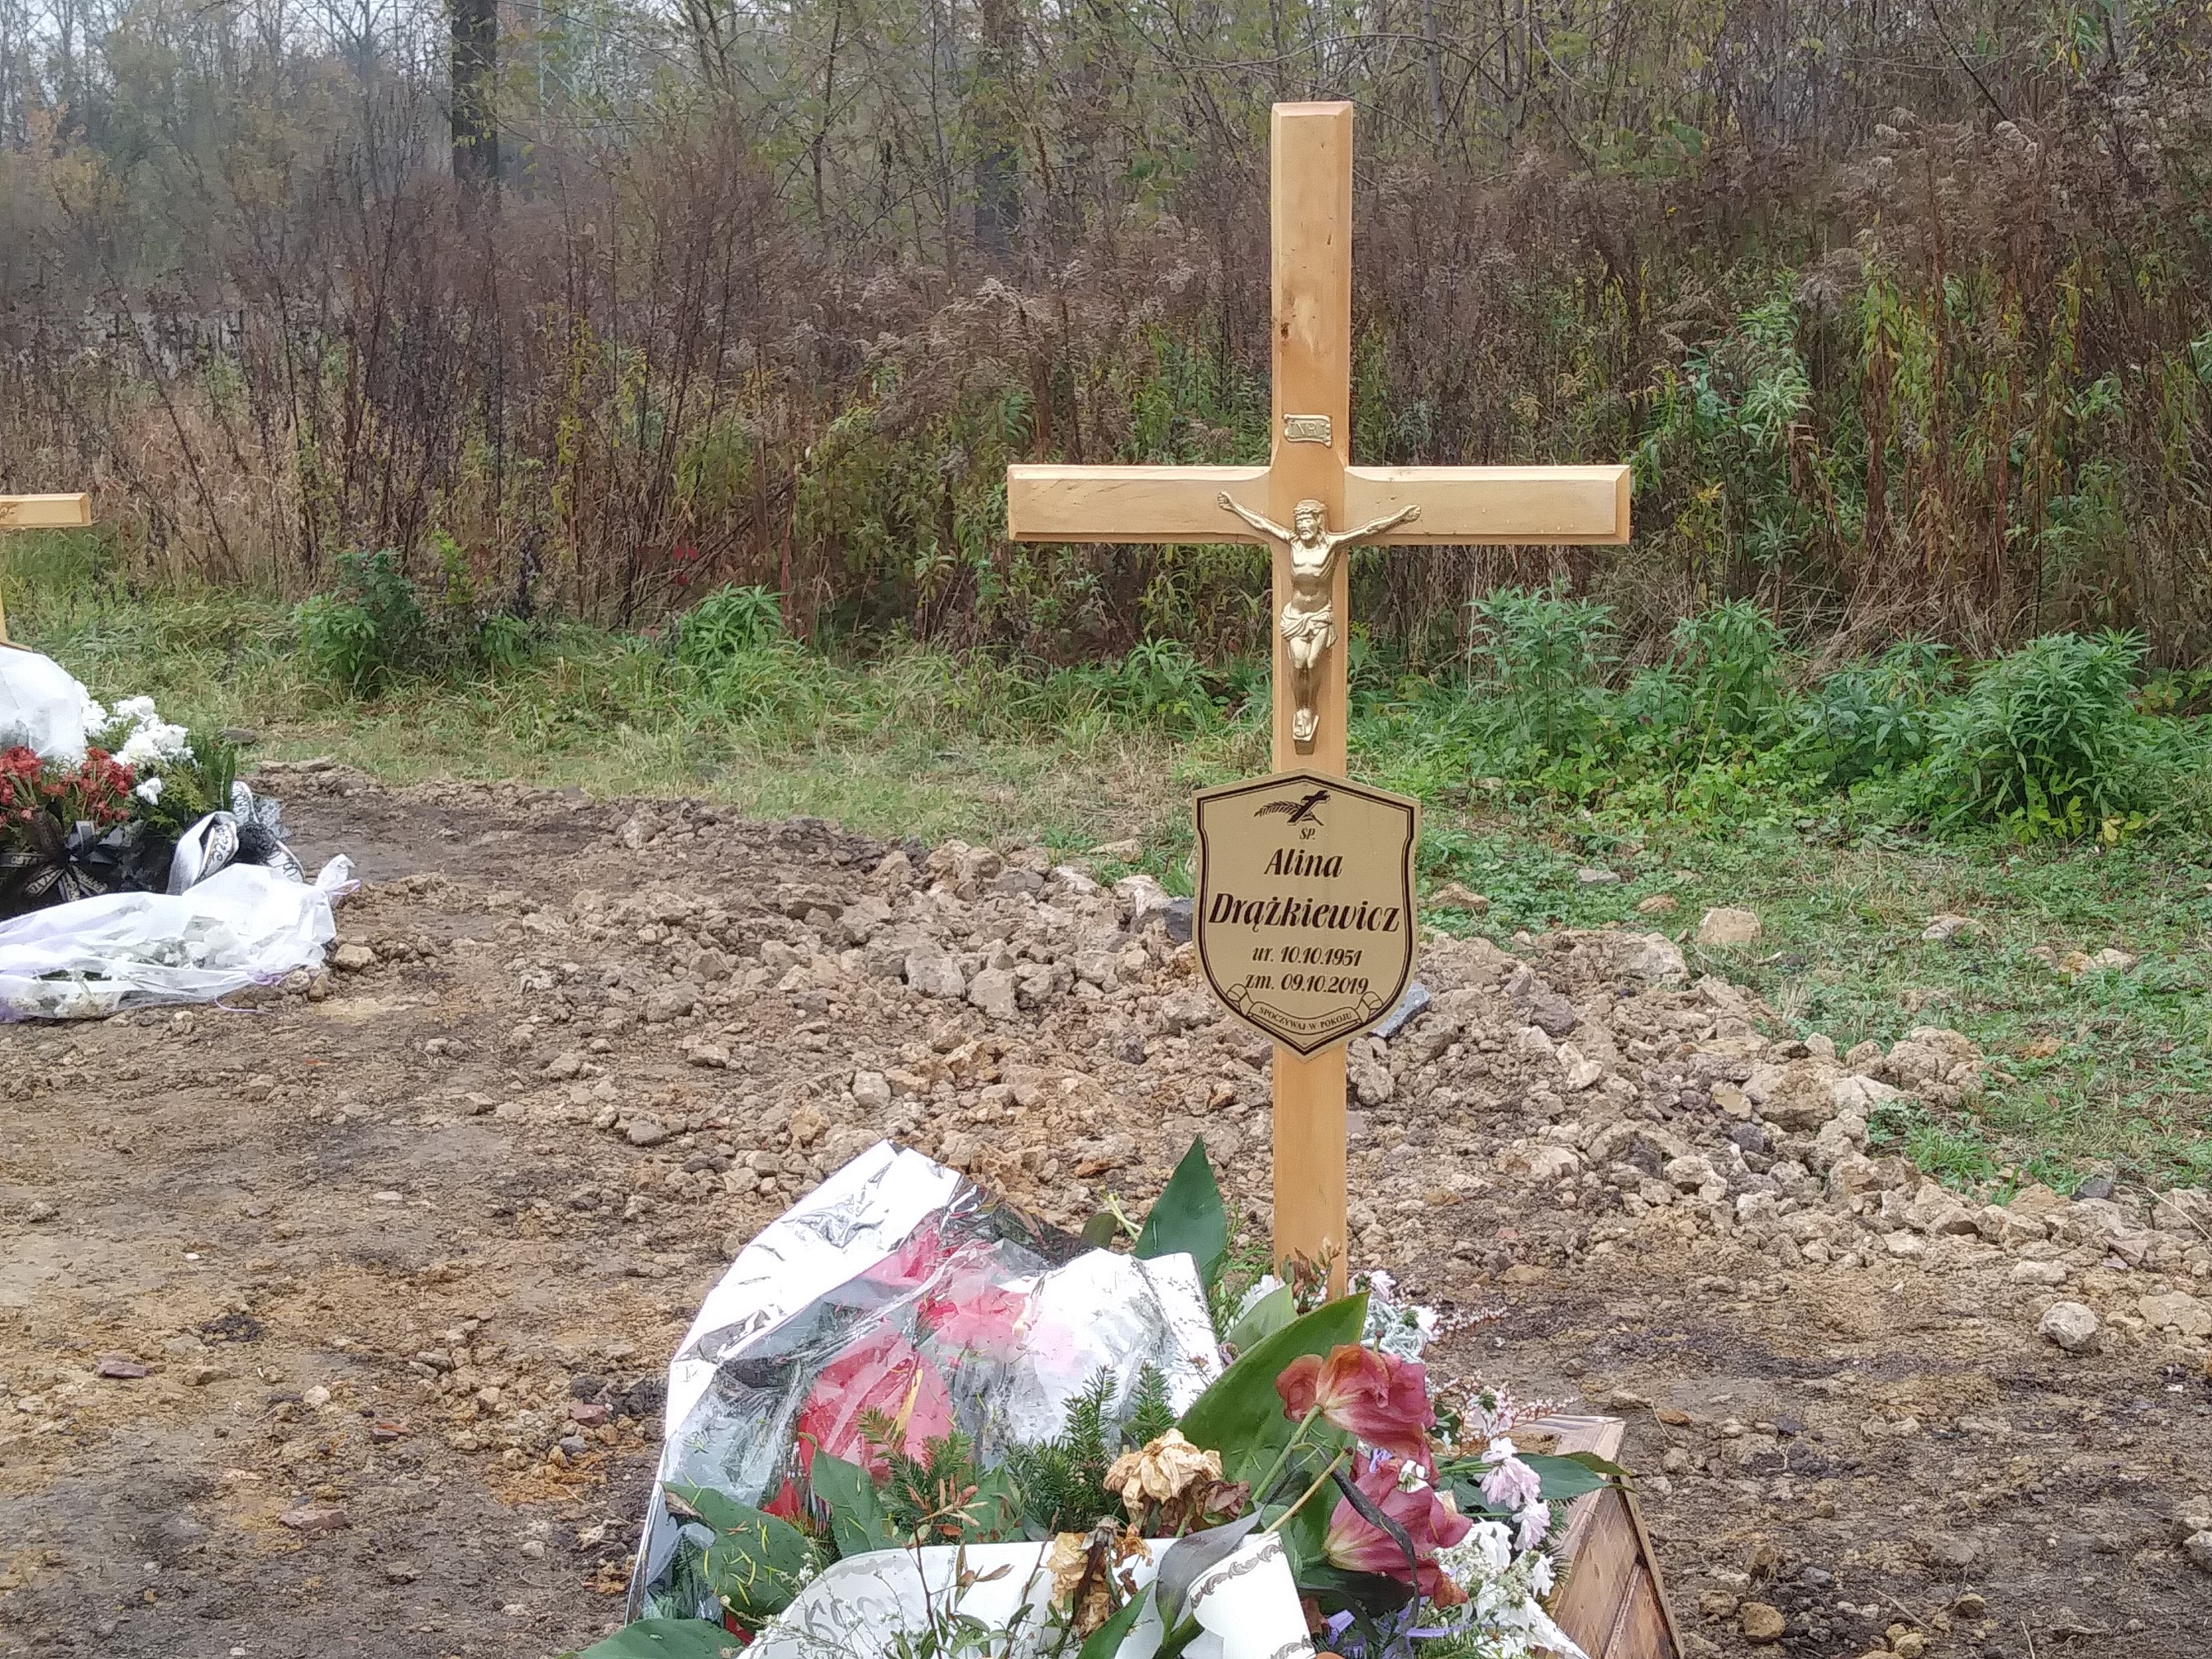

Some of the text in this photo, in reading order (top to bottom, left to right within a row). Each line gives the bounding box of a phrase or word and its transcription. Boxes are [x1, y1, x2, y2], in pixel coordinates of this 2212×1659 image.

[1264, 848, 1343, 878] Alina
[1208, 892, 1400, 933] Drążkiewicz
[1252, 946, 1363, 966] ur. 10.10.1951
[1245, 973, 1369, 995] zm. 09.10.2019
[1259, 1006, 1306, 1030] SPOCZYWAJ
[1320, 1011, 1352, 1028] POKOJU
